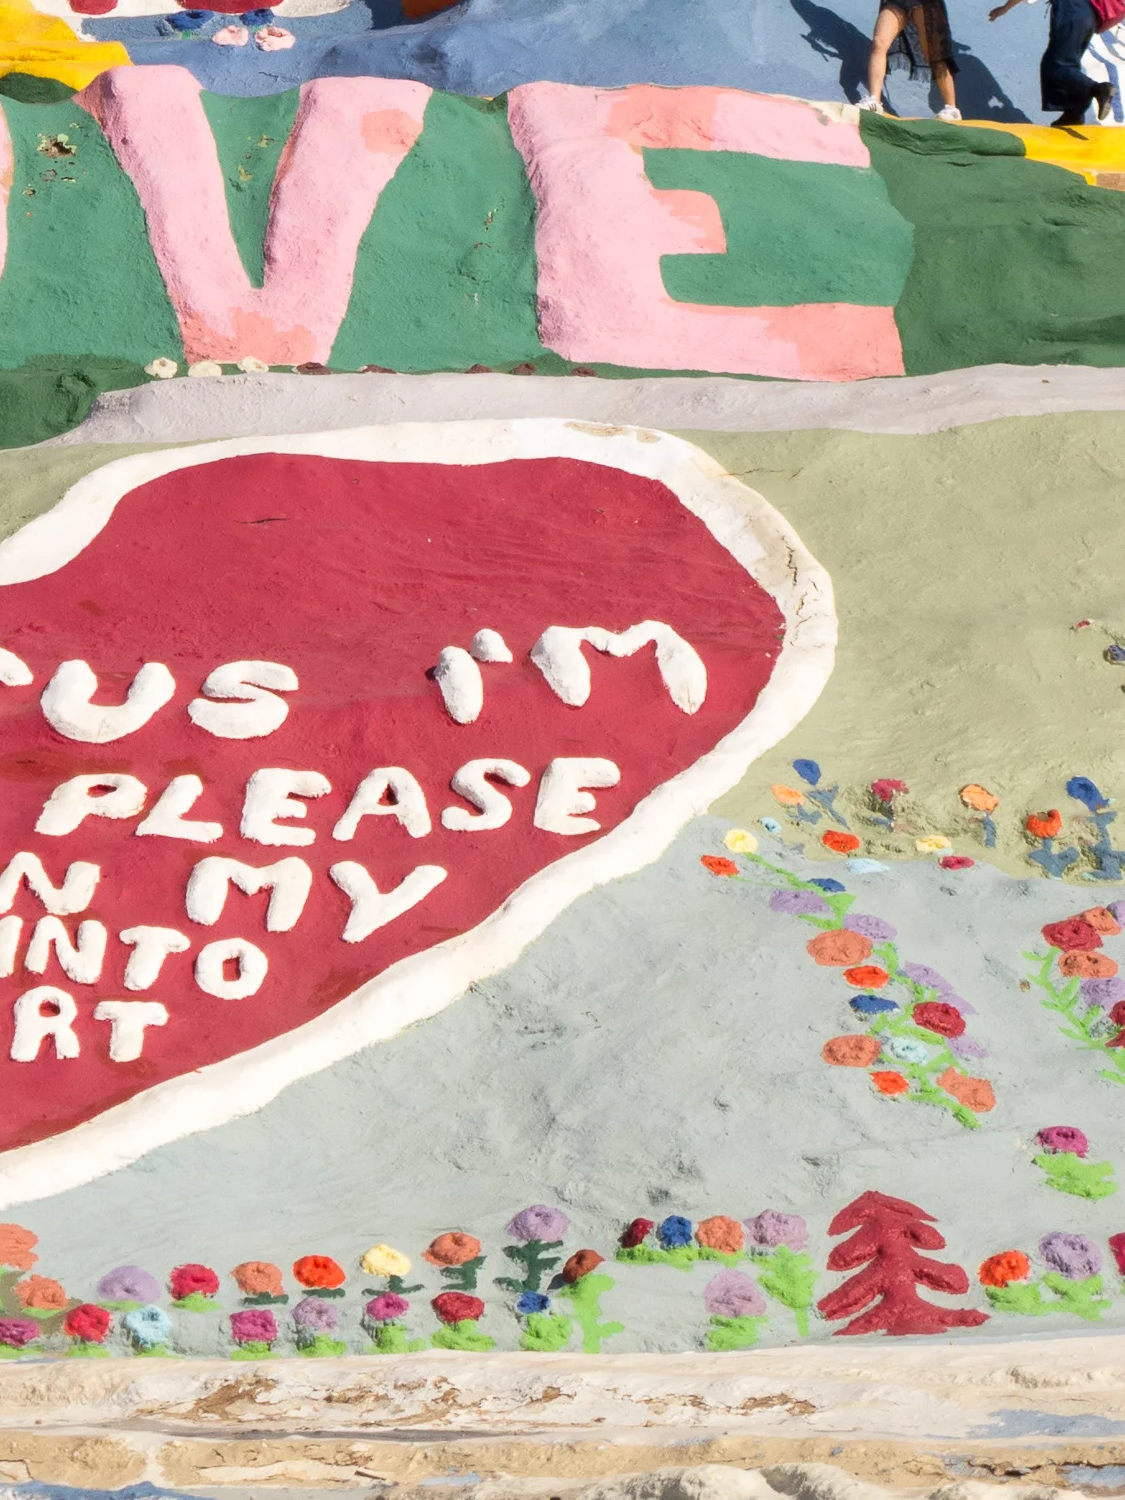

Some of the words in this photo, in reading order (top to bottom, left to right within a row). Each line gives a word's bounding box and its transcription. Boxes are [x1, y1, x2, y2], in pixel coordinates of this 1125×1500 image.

[435, 619, 708, 725] I'M
[33, 756, 621, 848] PLEASE
[185, 855, 449, 944] MY
